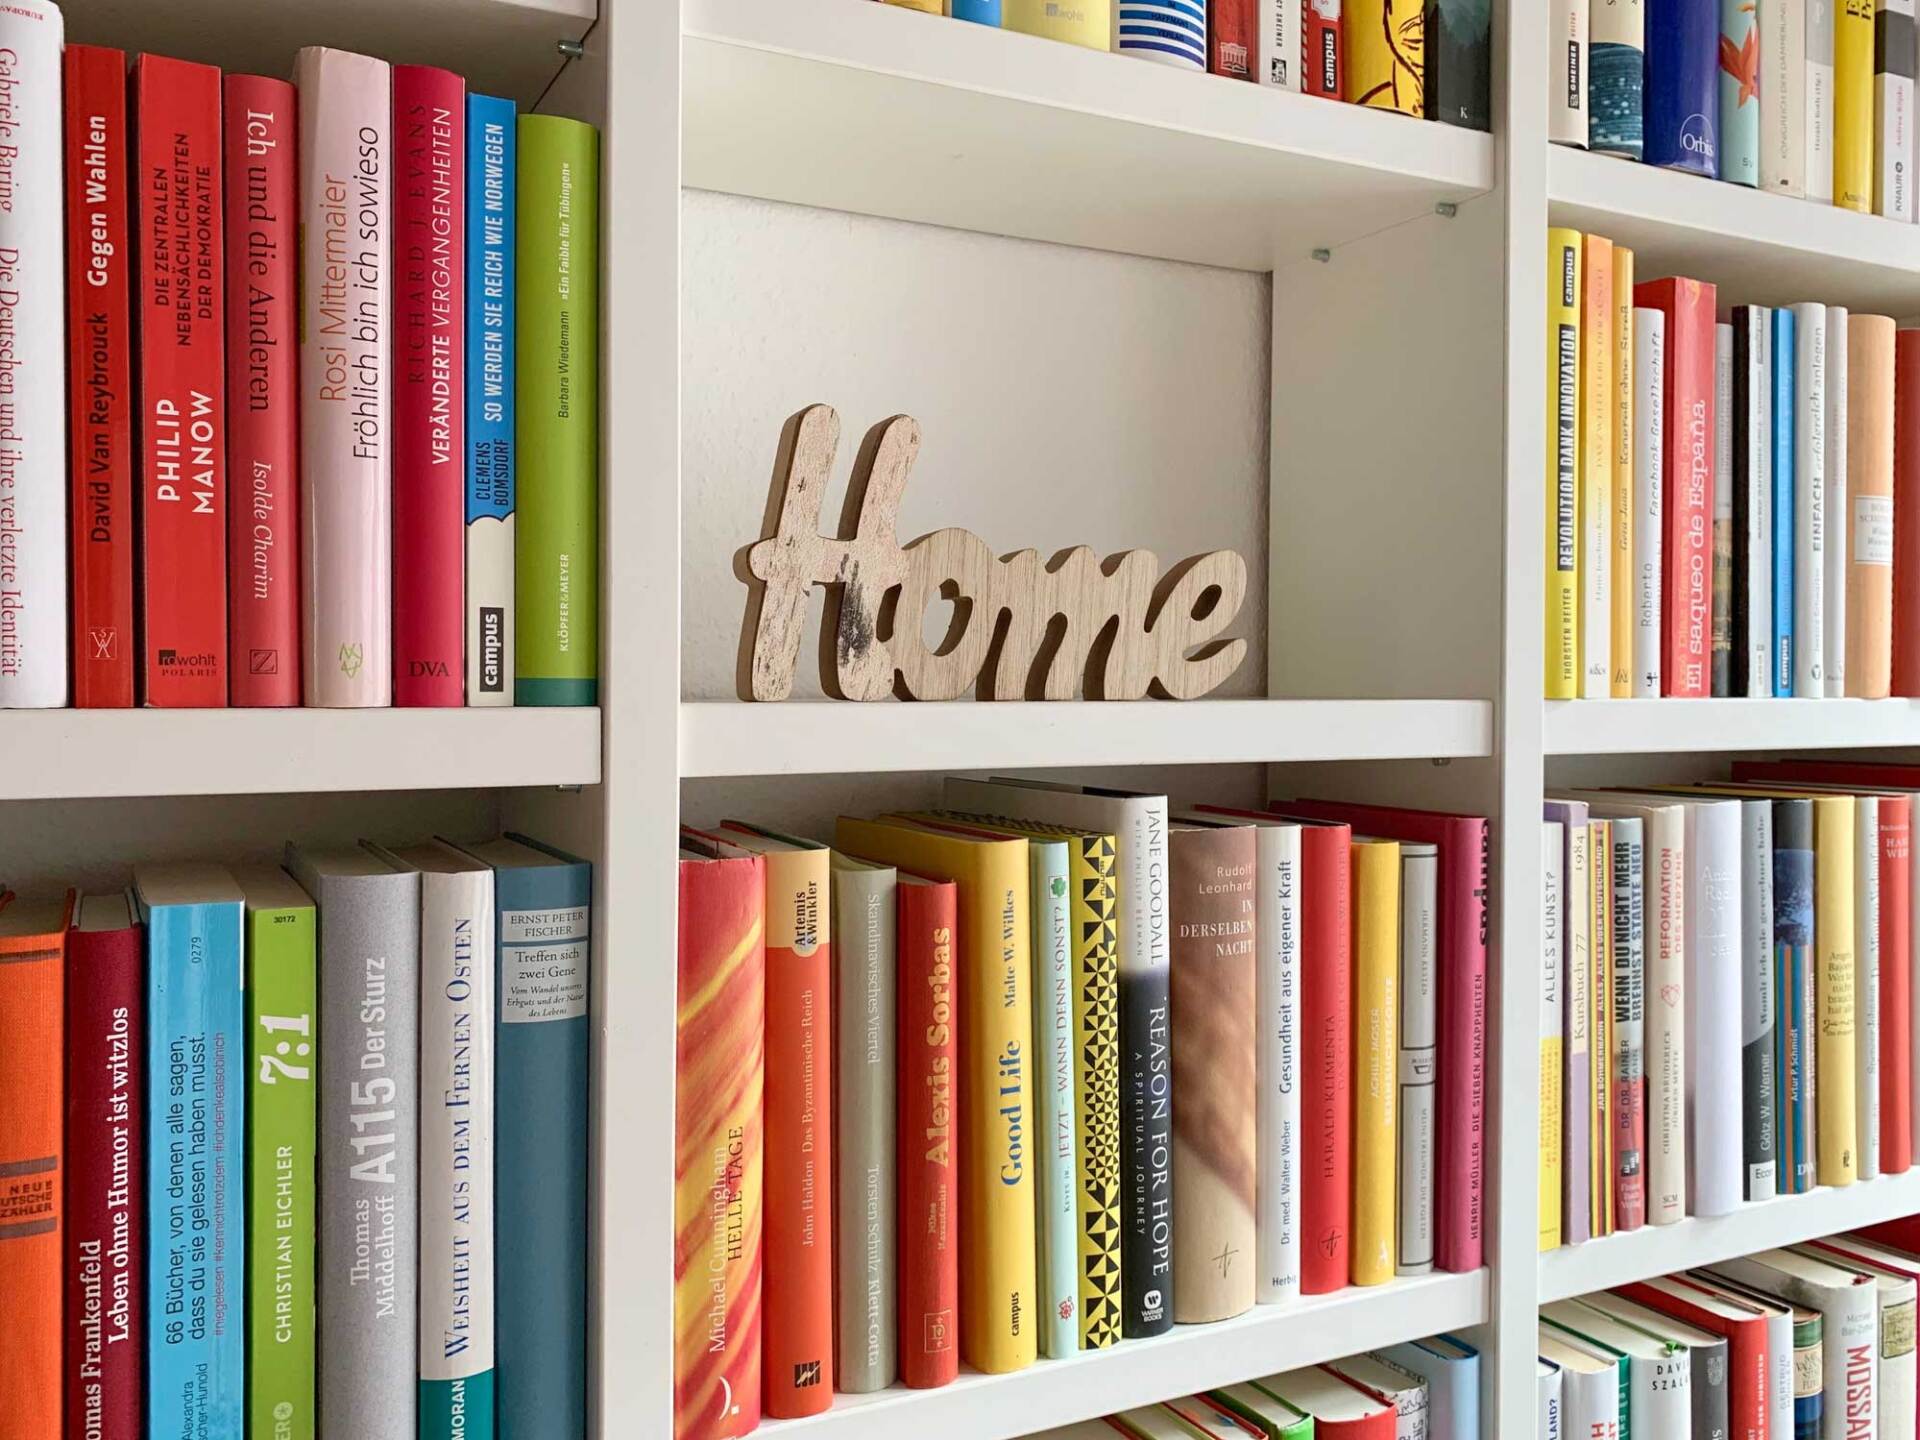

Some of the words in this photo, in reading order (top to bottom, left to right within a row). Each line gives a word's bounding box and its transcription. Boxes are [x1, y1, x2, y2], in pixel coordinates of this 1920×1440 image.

[1325, 32, 1336, 89] campus
[1569, 43, 1578, 92] GMEINER
[247, 109, 277, 155] Ich
[1459, 106, 1469, 119] K
[84, 116, 107, 205] Wahlen
[484, 123, 504, 212] NORWEGEN
[1682, 133, 1714, 157] Orbis
[248, 166, 277, 222] und
[352, 127, 379, 242] sowieso
[1894, 172, 1904, 212] KNAUR
[153, 167, 170, 271] ZENTRALEN
[195, 165, 213, 280] DEMOKRATIE
[431, 107, 452, 327] VERGANGENHEITEN
[484, 215, 504, 246] WIE
[558, 222, 571, 238] für
[87, 213, 114, 287] Gegen
[248, 232, 278, 276] die
[319, 176, 347, 335] Mittermaier
[351, 256, 378, 290] ich
[484, 250, 503, 298] REICH
[558, 240, 571, 274] Faible
[1563, 250, 1576, 304] campus
[154, 276, 171, 306] DIE
[197, 284, 213, 321] DER
[484, 302, 503, 327] SIE
[351, 298, 378, 343] bin
[557, 310, 571, 374] Wiedemann
[87, 312, 115, 426] Reybrouck
[249, 287, 278, 412] Anderen
[319, 346, 347, 401] Rosi
[484, 331, 503, 397] WERDEN
[1560, 329, 1575, 422] INNOVATION
[351, 354, 379, 460] Fröhlich
[428, 335, 451, 465] VERÄNDERTE
[484, 402, 503, 422] SO
[557, 376, 569, 419] Barbara
[88, 430, 109, 477] Van
[156, 399, 181, 501] PHILIP
[190, 391, 215, 513] MANOW
[475, 441, 492, 501] CLEMENS
[1560, 427, 1575, 467] DANK
[1687, 399, 1708, 510] España
[90, 483, 112, 543] David
[253, 461, 273, 520] Isolde
[1812, 477, 1822, 552] EINFACH
[1559, 470, 1575, 567] REVOLUTION
[1688, 514, 1705, 549] de
[253, 525, 274, 600] Charim
[733, 402, 1248, 702] Home
[1562, 587, 1573, 624] REITER
[1640, 562, 1653, 627] Roberto
[1689, 553, 1707, 655] saqueo
[161, 667, 218, 677] POLARIS
[407, 660, 450, 677] DVA
[484, 613, 503, 687] campus
[1562, 627, 1573, 681] THORSTEN
[1686, 661, 1703, 691] El
[1780, 638, 1790, 686] campus
[1216, 865, 1254, 879] Rudolf
[1277, 859, 1292, 899] Kraft
[1573, 834, 1585, 872] 1984
[1615, 841, 1631, 888] MEHR
[1630, 843, 1642, 875] NEU
[510, 914, 549, 925] ERNST
[551, 910, 585, 923] PETER
[523, 924, 574, 938] FISCHER
[794, 891, 808, 947] Artemis
[1002, 889, 1016, 940] Wilkes
[1241, 900, 1254, 914] IN
[1545, 871, 1556, 940] KUNST?
[1614, 894, 1631, 943] NICHT
[1630, 880, 1642, 940] STARTE
[1659, 847, 1673, 961] REFORMATION
[190, 936, 203, 965] 0279
[514, 950, 558, 965] Treffen
[560, 947, 580, 962] sich
[866, 893, 880, 1015] Skandinavisches
[1002, 943, 1016, 962] W.
[1053, 905, 1068, 972] SONST?
[1278, 904, 1296, 965] eigener
[1575, 932, 1587, 953] 77
[1614, 945, 1630, 968] DU
[358, 956, 387, 1025] Sturz
[518, 966, 545, 980] zwei
[547, 965, 577, 978] Gene
[925, 926, 952, 1048] Sorbas
[1002, 966, 1017, 1009] Malte
[1281, 970, 1293, 998] aus
[1545, 946, 1556, 1004] ALLES
[1614, 974, 1631, 1023] WENN
[527, 1008, 542, 1018] des
[800, 989, 815, 1028] Reich
[1055, 976, 1068, 1030] DENN
[1472, 973, 1484, 1060] KNAPPHEITEN
[1573, 960, 1585, 1041] Kursbuch
[106, 1006, 129, 1089] witzlos
[360, 1027, 386, 1070] Der
[866, 1015, 881, 1064] Viertel
[1056, 1036, 1069, 1093] WANN
[1149, 1006, 1170, 1120] REASON
[1277, 1003, 1293, 1095] Gesundheit
[1323, 1013, 1336, 1102] KLIMENTA
[1620, 1039, 1631, 1084] RAINER
[1790, 1028, 1800, 1066] Schmidt
[998, 1039, 1023, 1098] Life
[1471, 1062, 1483, 1108] SIEBEN
[1759, 1053, 1773, 1098] Werner
[106, 1093, 129, 1122] ist
[165, 1102, 184, 1135] alle
[187, 1097, 206, 1155] haben
[349, 1076, 397, 1184] A115
[924, 1055, 952, 1168] Alexis
[1134, 1072, 1145, 1154] SPIRITUAL
[1471, 1111, 1482, 1132] DIE
[1662, 1096, 1672, 1155] CHRISTINA
[801, 1126, 815, 1153] Das
[998, 1105, 1024, 1186] Good
[1151, 1131, 1169, 1193] FOR
[1280, 1119, 1292, 1157] Weber
[1323, 1107, 1336, 1179] HARALD
[1759, 1121, 1773, 1151] Götz
[107, 1126, 129, 1210] Humor
[165, 1141, 185, 1199] denen
[275, 1144, 294, 1231] EICHLER
[801, 1160, 816, 1211] Haldon
[866, 1164, 881, 1219] Torsten
[1280, 1159, 1292, 1196] Walter
[171, 1204, 185, 1239] von
[187, 1160, 210, 1231] gelesen
[1134, 1165, 1146, 1236] JOURNEY
[1280, 1198, 1292, 1226] med.
[1468, 1194, 1481, 1241] HENRIK
[107, 1211, 129, 1269] ohne
[187, 1236, 206, 1263] sie
[349, 1198, 371, 1286] Thomas
[801, 1212, 816, 1248] John
[866, 1223, 881, 1272] Schulz
[1151, 1199, 1171, 1277] HOPE
[1280, 1229, 1292, 1245] Dr.
[187, 1267, 206, 1291] du
[273, 1233, 293, 1343] CHRISTIAN
[107, 1270, 129, 1345] Leben
[165, 1320, 185, 1345] 66
[187, 1295, 206, 1340] dass
[866, 1278, 881, 1367] Klett-Cotta
[1009, 1290, 1023, 1337] campus
